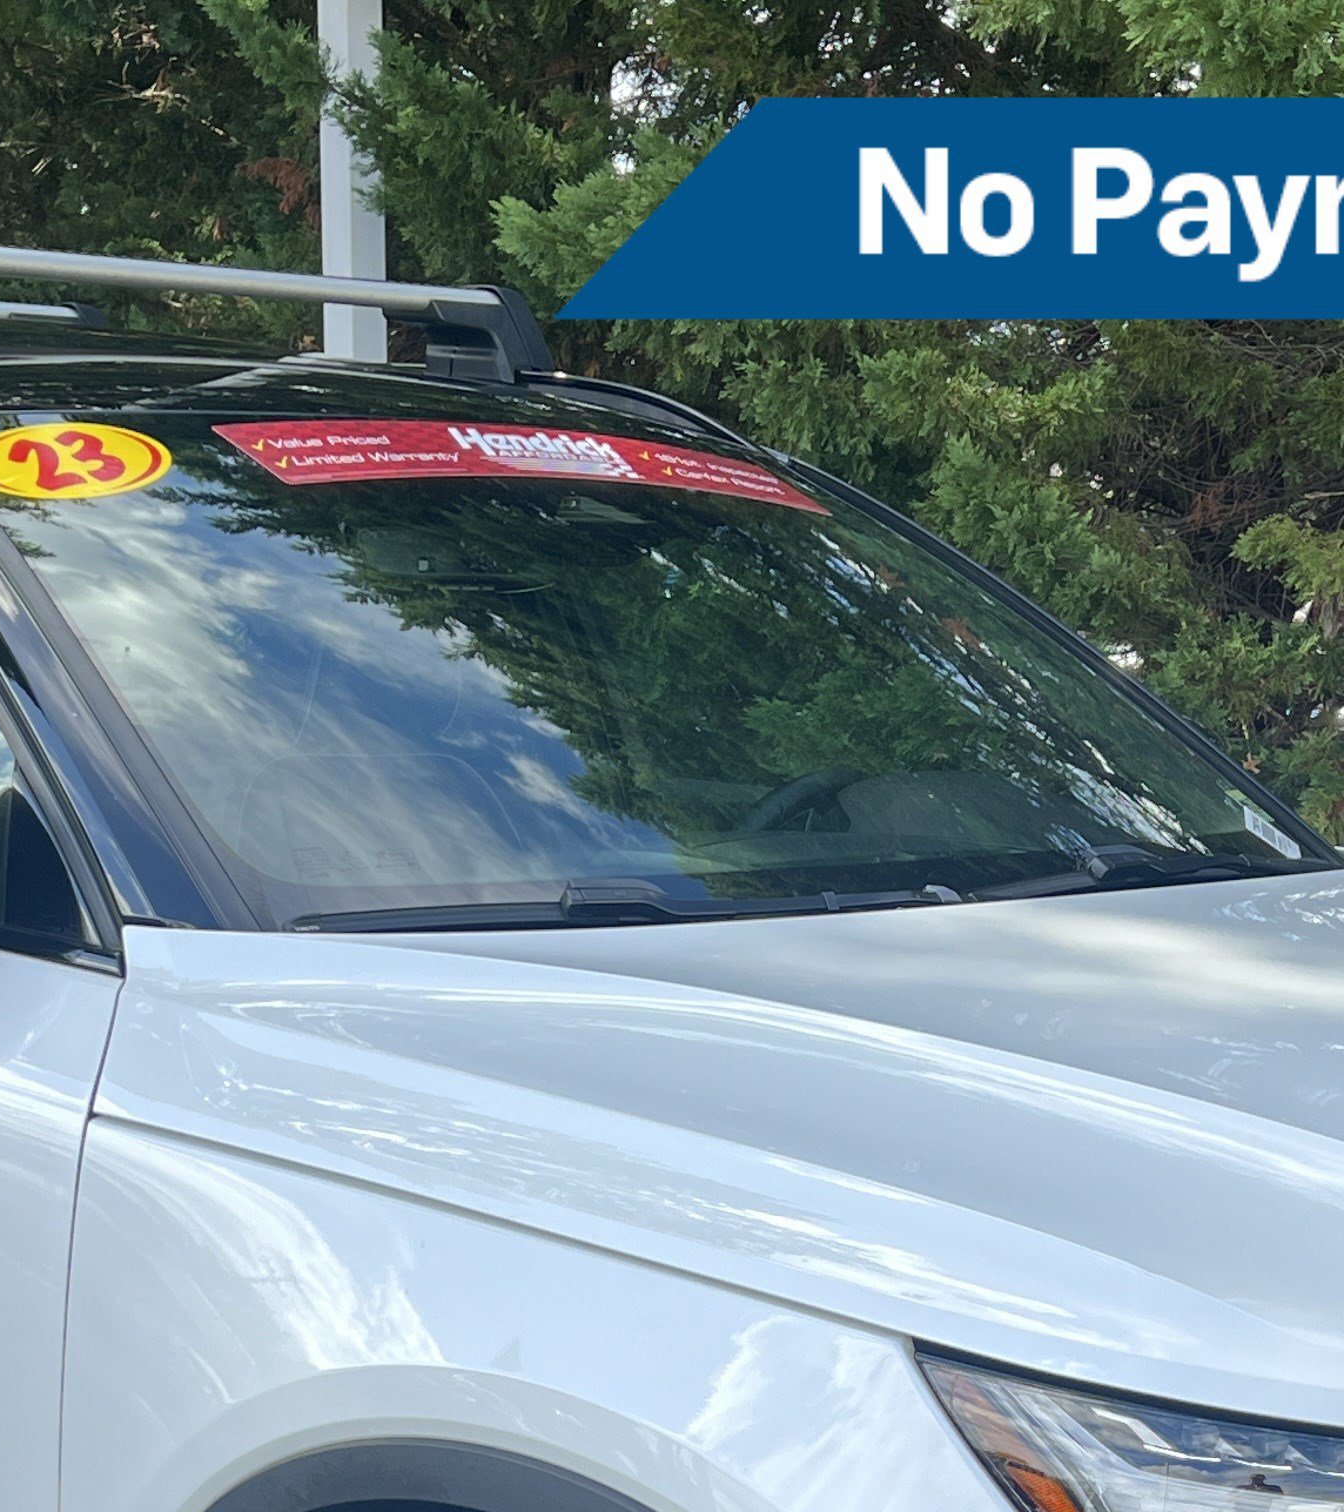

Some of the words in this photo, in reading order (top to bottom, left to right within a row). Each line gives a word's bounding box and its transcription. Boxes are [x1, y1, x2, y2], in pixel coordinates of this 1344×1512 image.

[267, 437, 323, 449] Value
[327, 434, 391, 447] Priced
[447, 427, 624, 460] Hendrick
[8, 430, 127, 491] 23
[291, 452, 365, 467] Limited
[367, 451, 460, 463] Warranty
